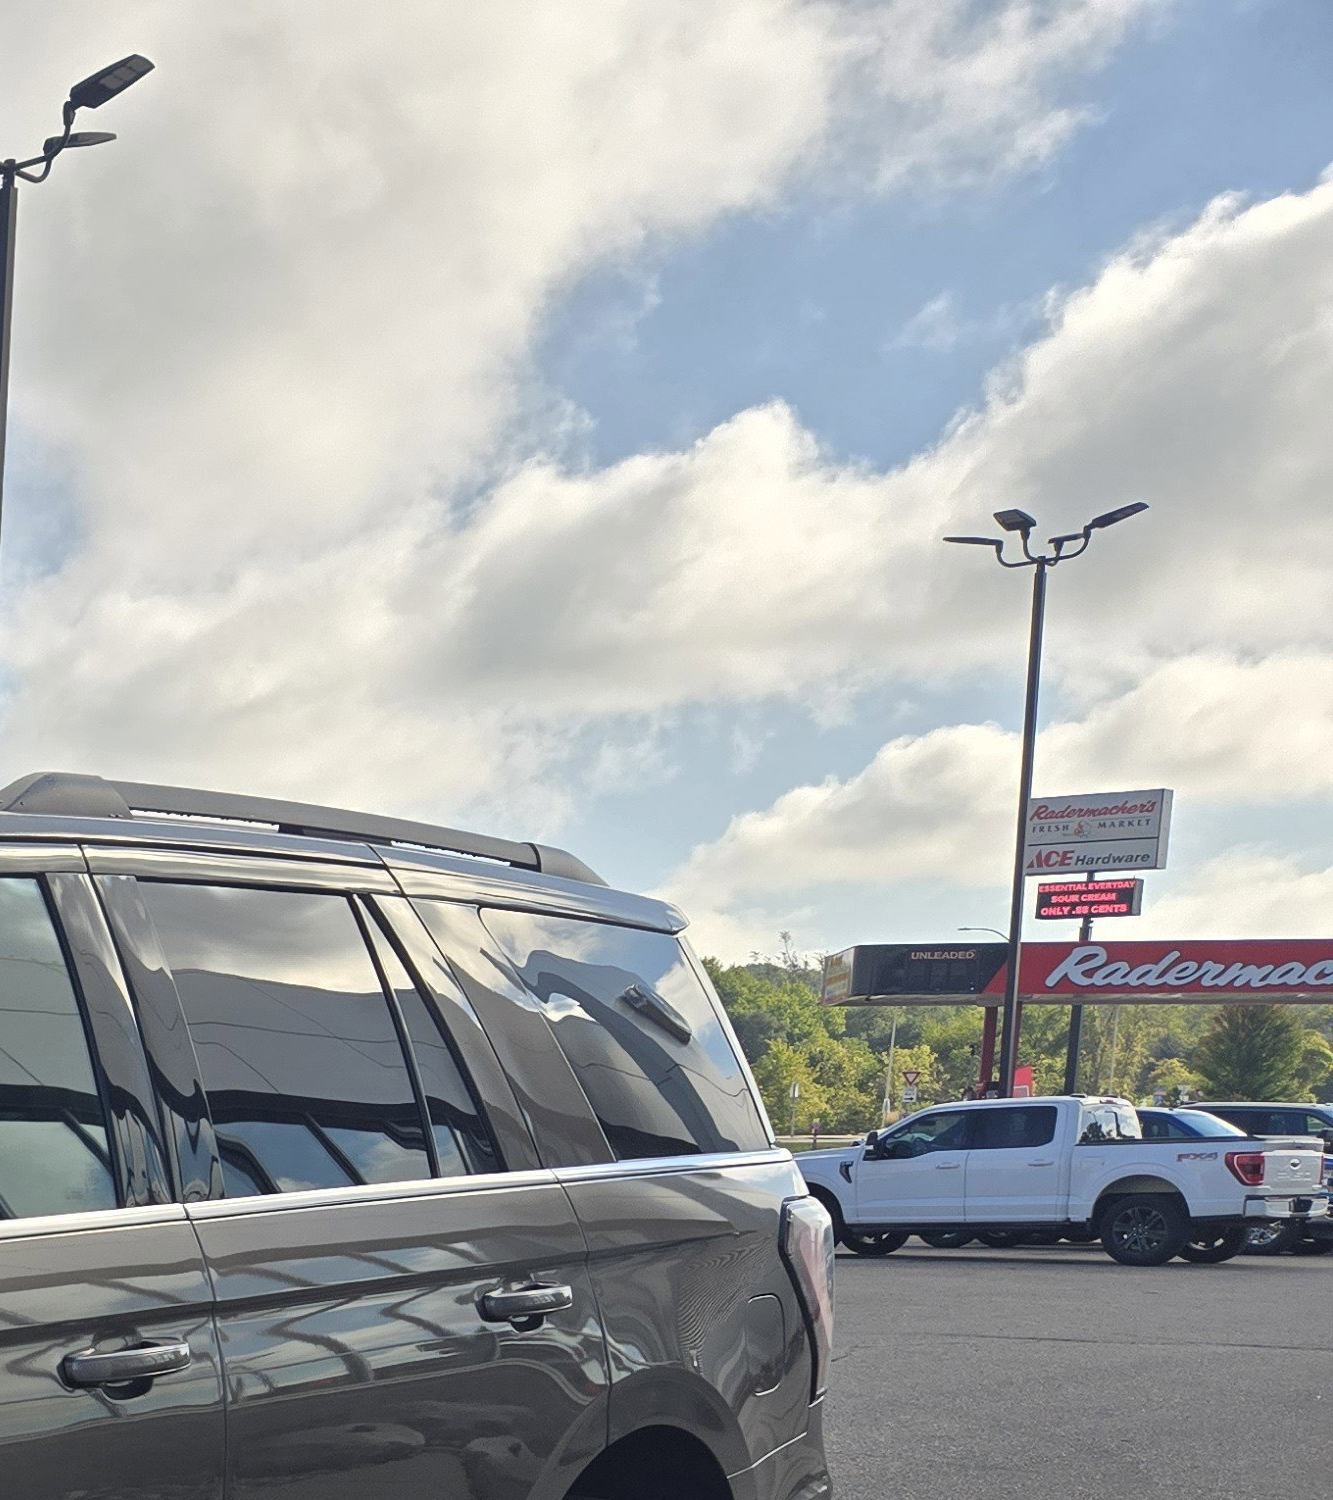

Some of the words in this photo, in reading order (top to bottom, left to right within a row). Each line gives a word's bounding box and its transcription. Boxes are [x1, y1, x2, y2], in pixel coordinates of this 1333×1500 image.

[1030, 800, 1157, 821] Radermacher's
[1032, 824, 1070, 833] FRESH
[1097, 818, 1151, 829] MARKET
[1026, 849, 1075, 869] ACE
[1075, 853, 1151, 866] Hardware
[1038, 882, 1087, 893] ESSENTIAL
[1088, 880, 1136, 890] EVERYDAY
[1051, 894, 1080, 903] SOUR
[1081, 893, 1117, 902] CREAM
[1040, 906, 1071, 915] ONLY
[1090, 904, 1128, 914] CENTS
[911, 950, 976, 960] UNLEADED
[1177, 1152, 1218, 1163] FX4
